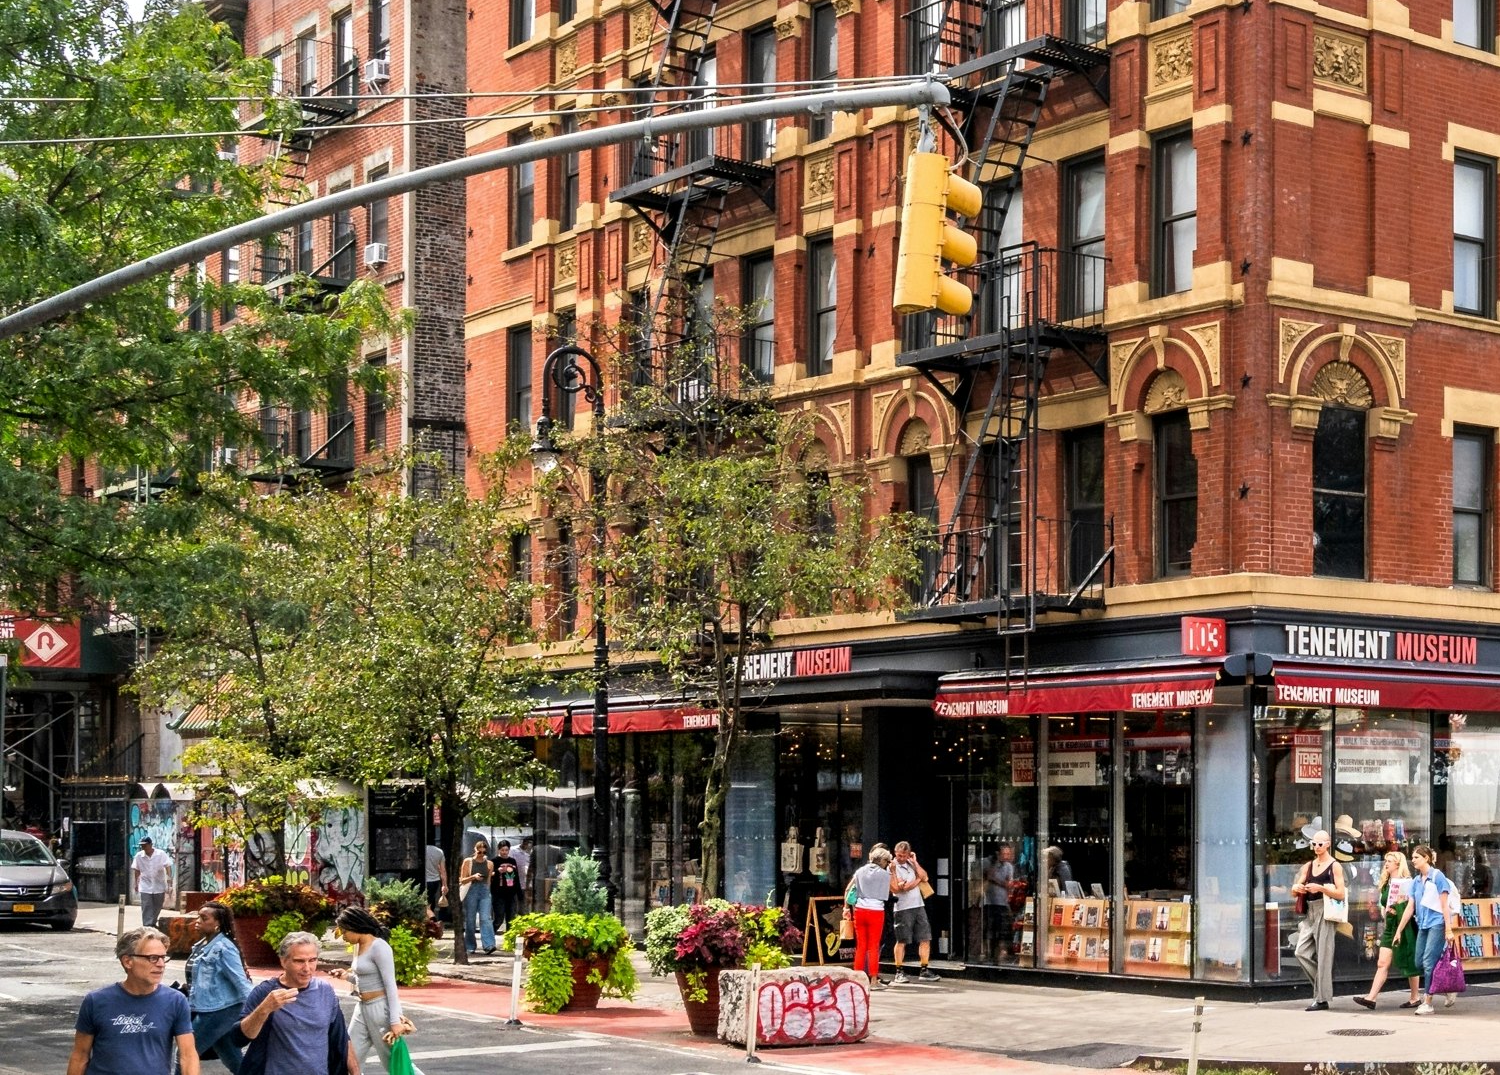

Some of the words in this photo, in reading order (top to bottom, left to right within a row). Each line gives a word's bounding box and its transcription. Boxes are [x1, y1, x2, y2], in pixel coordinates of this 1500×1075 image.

[1285, 625, 1390, 659] TENEMENT
[1396, 632, 1477, 664] MUSEUM
[796, 647, 850, 676] MUSEUM
[1132, 691, 1174, 708] TENEMENT
[1176, 689, 1213, 707] MUSEUM
[1277, 684, 1332, 704] TENEMENT
[1335, 687, 1380, 705] MUSEUM
[935, 701, 975, 716] TENEMENT
[976, 700, 1008, 714] MUSEUM
[683, 715, 711, 728] TENEMENT
[111, 1014, 147, 1025] Rebel
